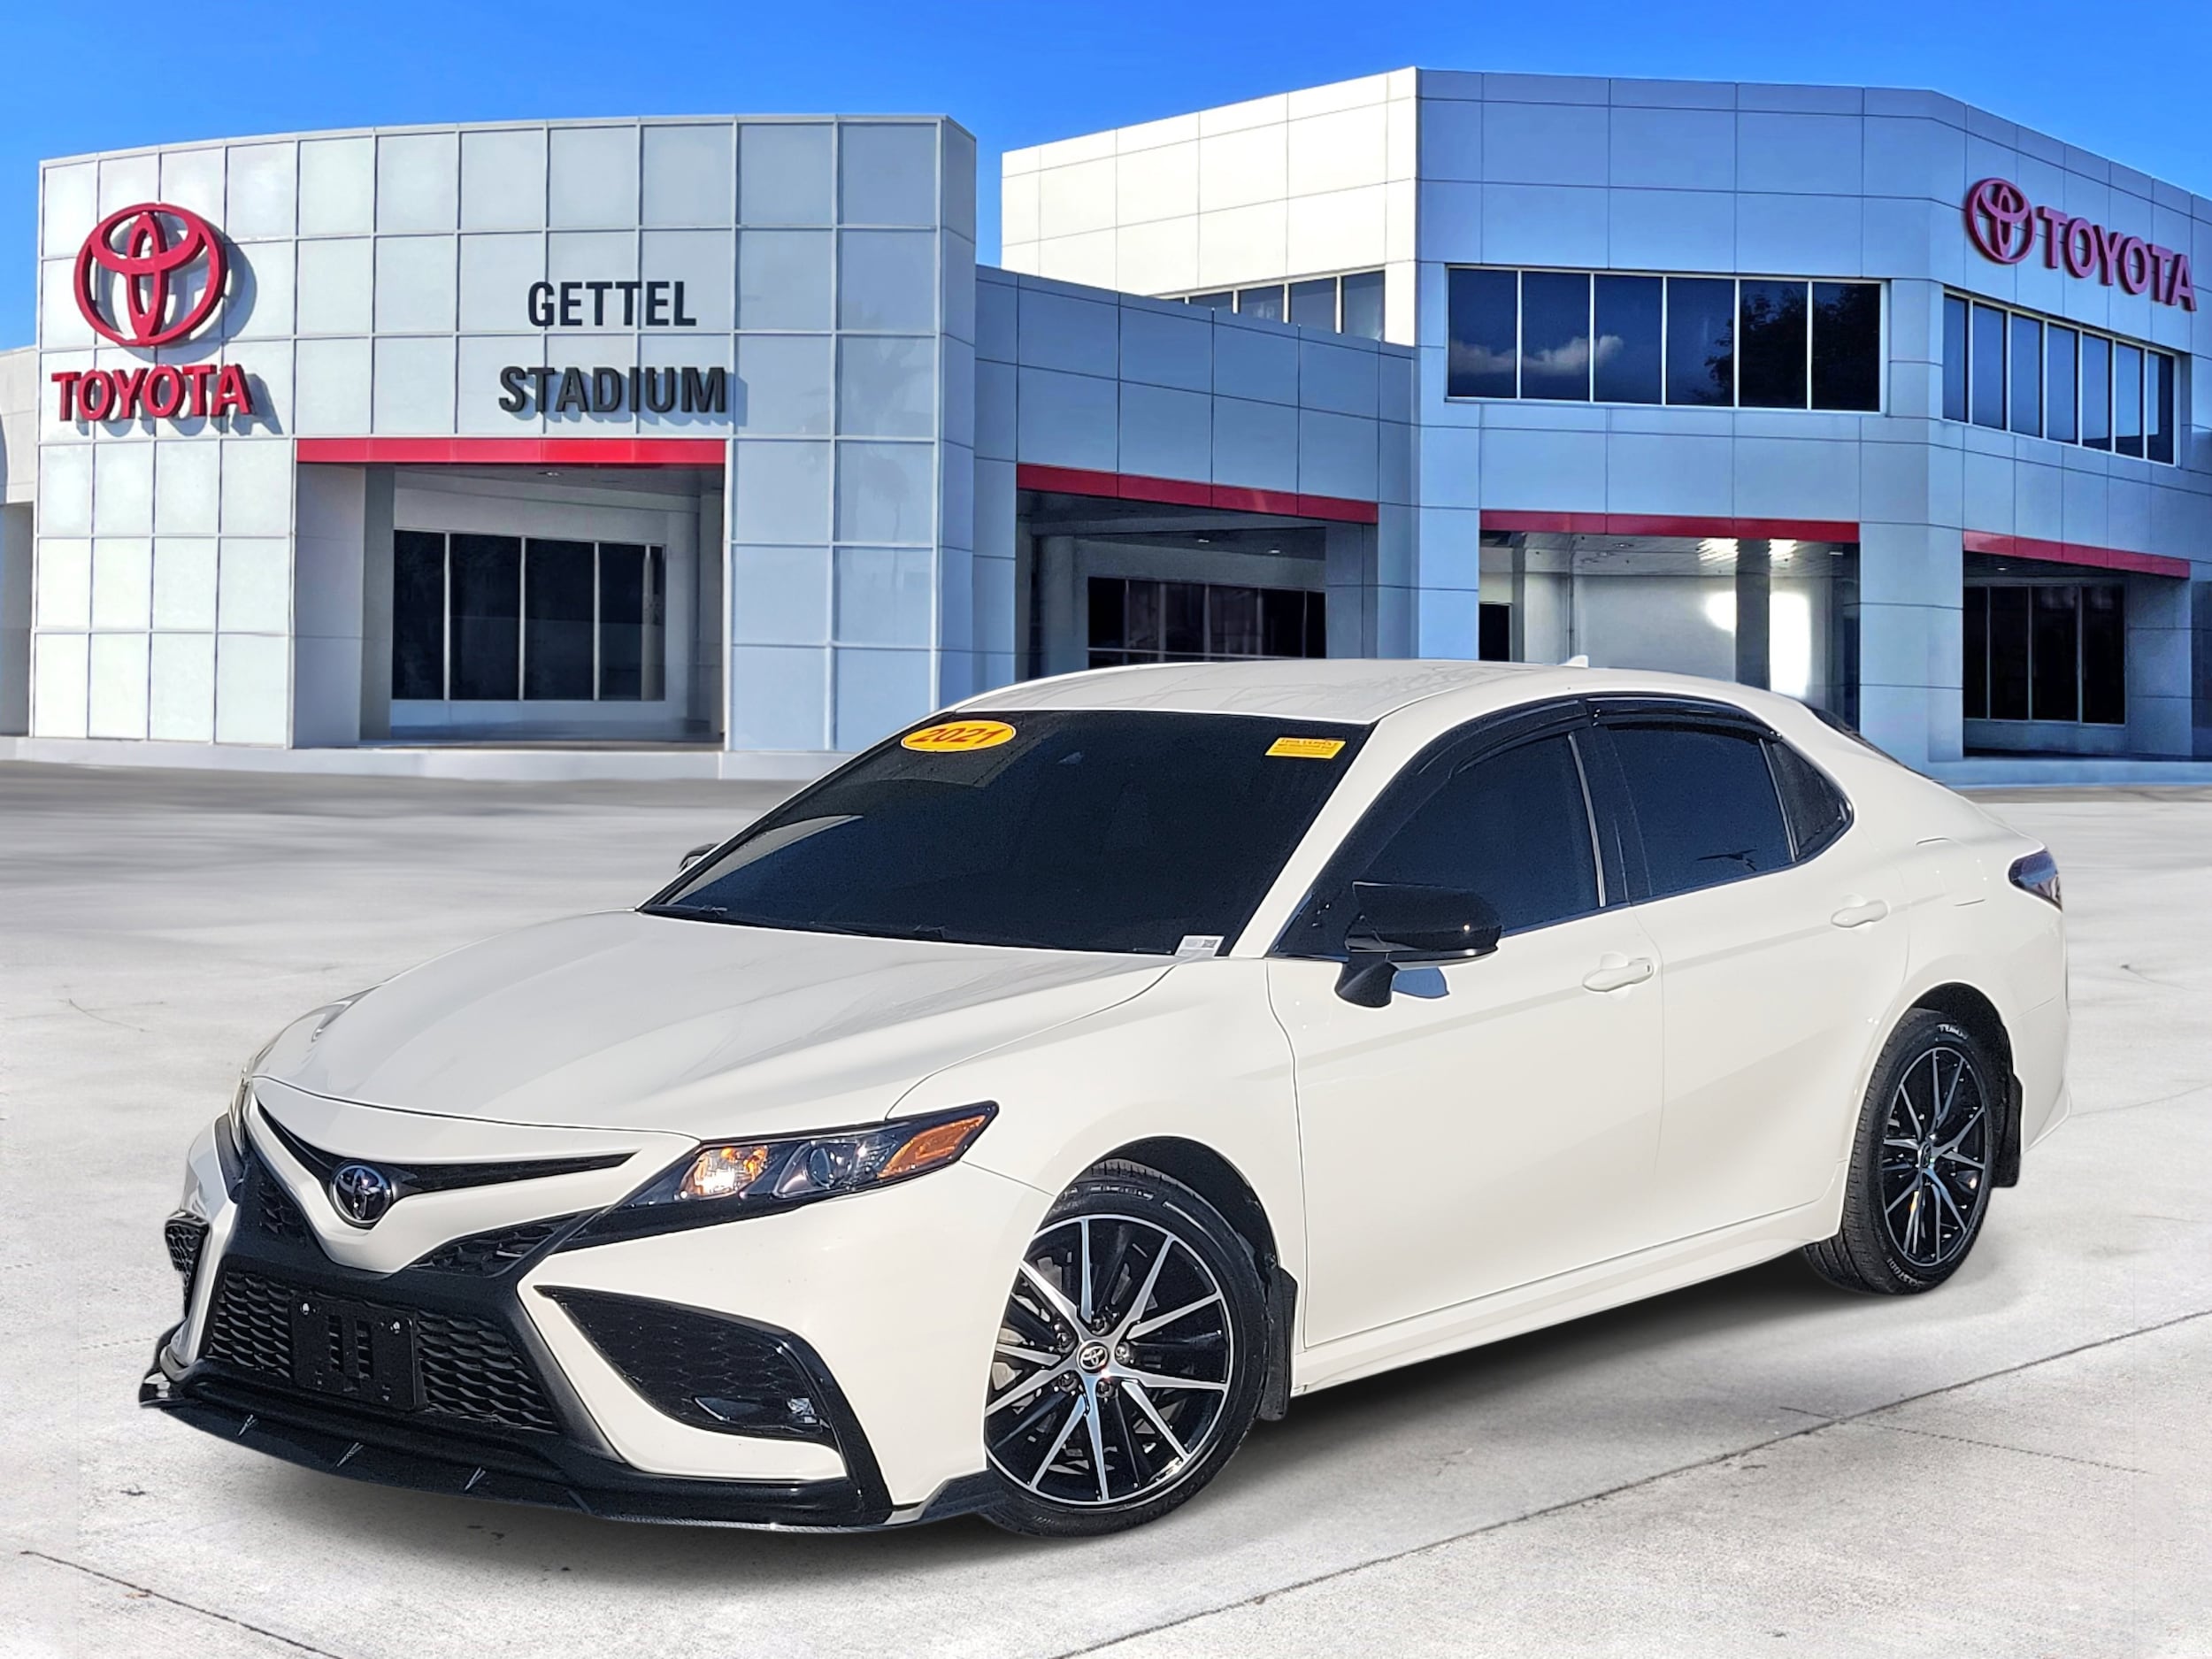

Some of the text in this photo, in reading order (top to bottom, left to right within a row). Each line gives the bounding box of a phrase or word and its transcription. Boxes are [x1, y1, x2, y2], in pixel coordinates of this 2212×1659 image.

[2037, 205, 2197, 311] TOYOTA
[527, 280, 697, 327] GETTEL
[50, 363, 256, 422] TOYOTA
[498, 365, 726, 413] STADIUM
[910, 727, 1008, 744] 2021
